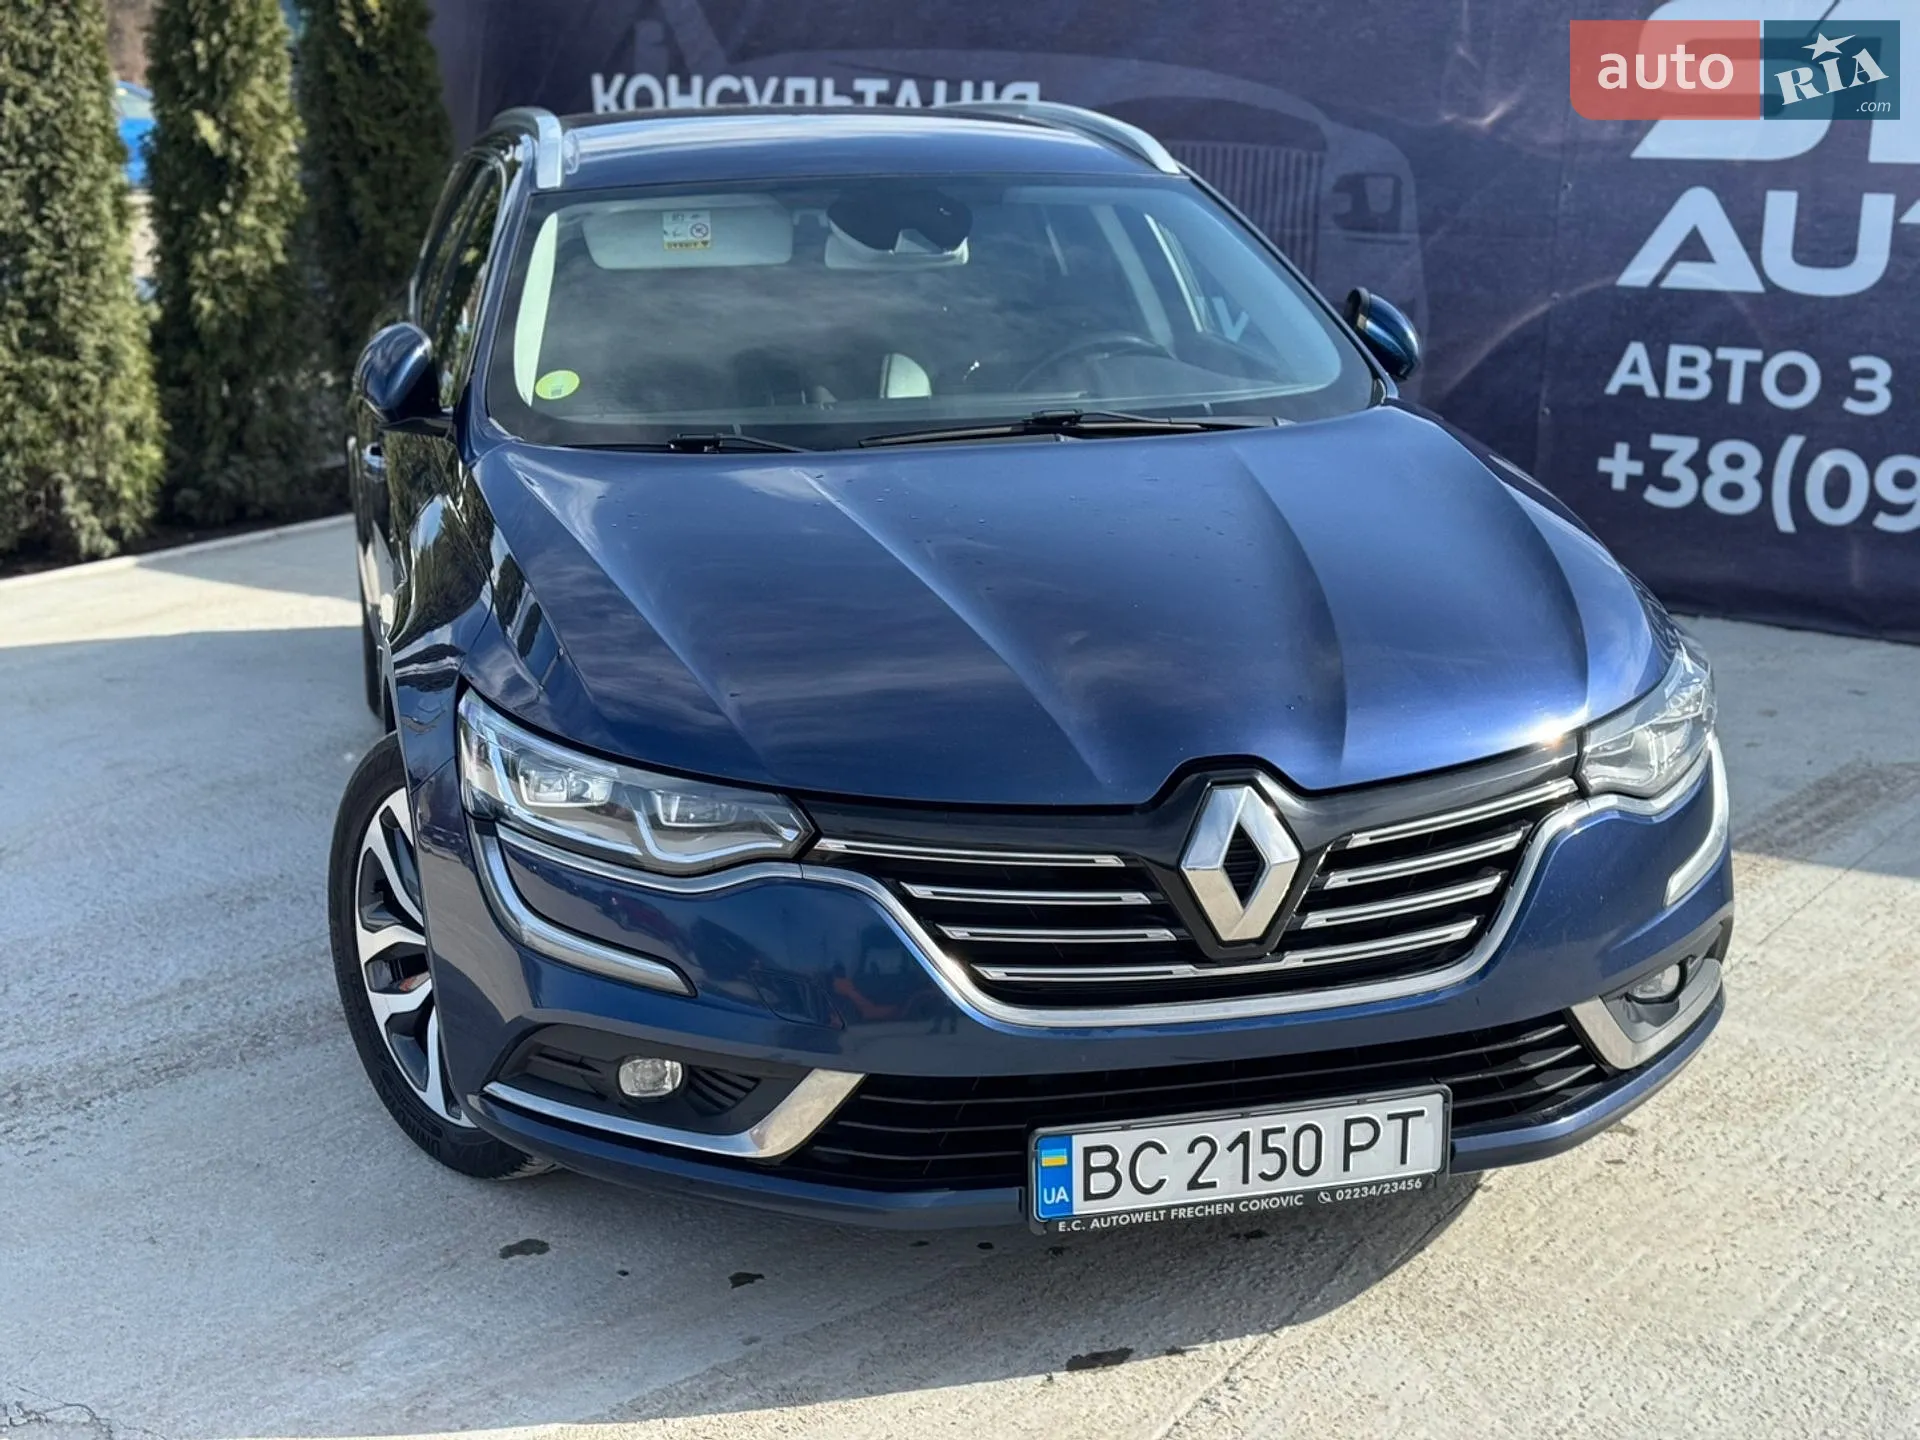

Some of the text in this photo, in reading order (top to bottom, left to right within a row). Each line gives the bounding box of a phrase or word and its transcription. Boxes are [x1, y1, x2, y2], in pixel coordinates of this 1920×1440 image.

[1615, 186, 1920, 297] AU
[1604, 341, 1822, 410] АВТО
[1597, 433, 1920, 534] +38(09
[1043, 1186, 1070, 1205] UA
[1082, 1109, 1426, 1202] BC 2150 PT
[1058, 1177, 1423, 1232] E.C. AUTOWELT FRECHEN COKOVIC 02234/23456
